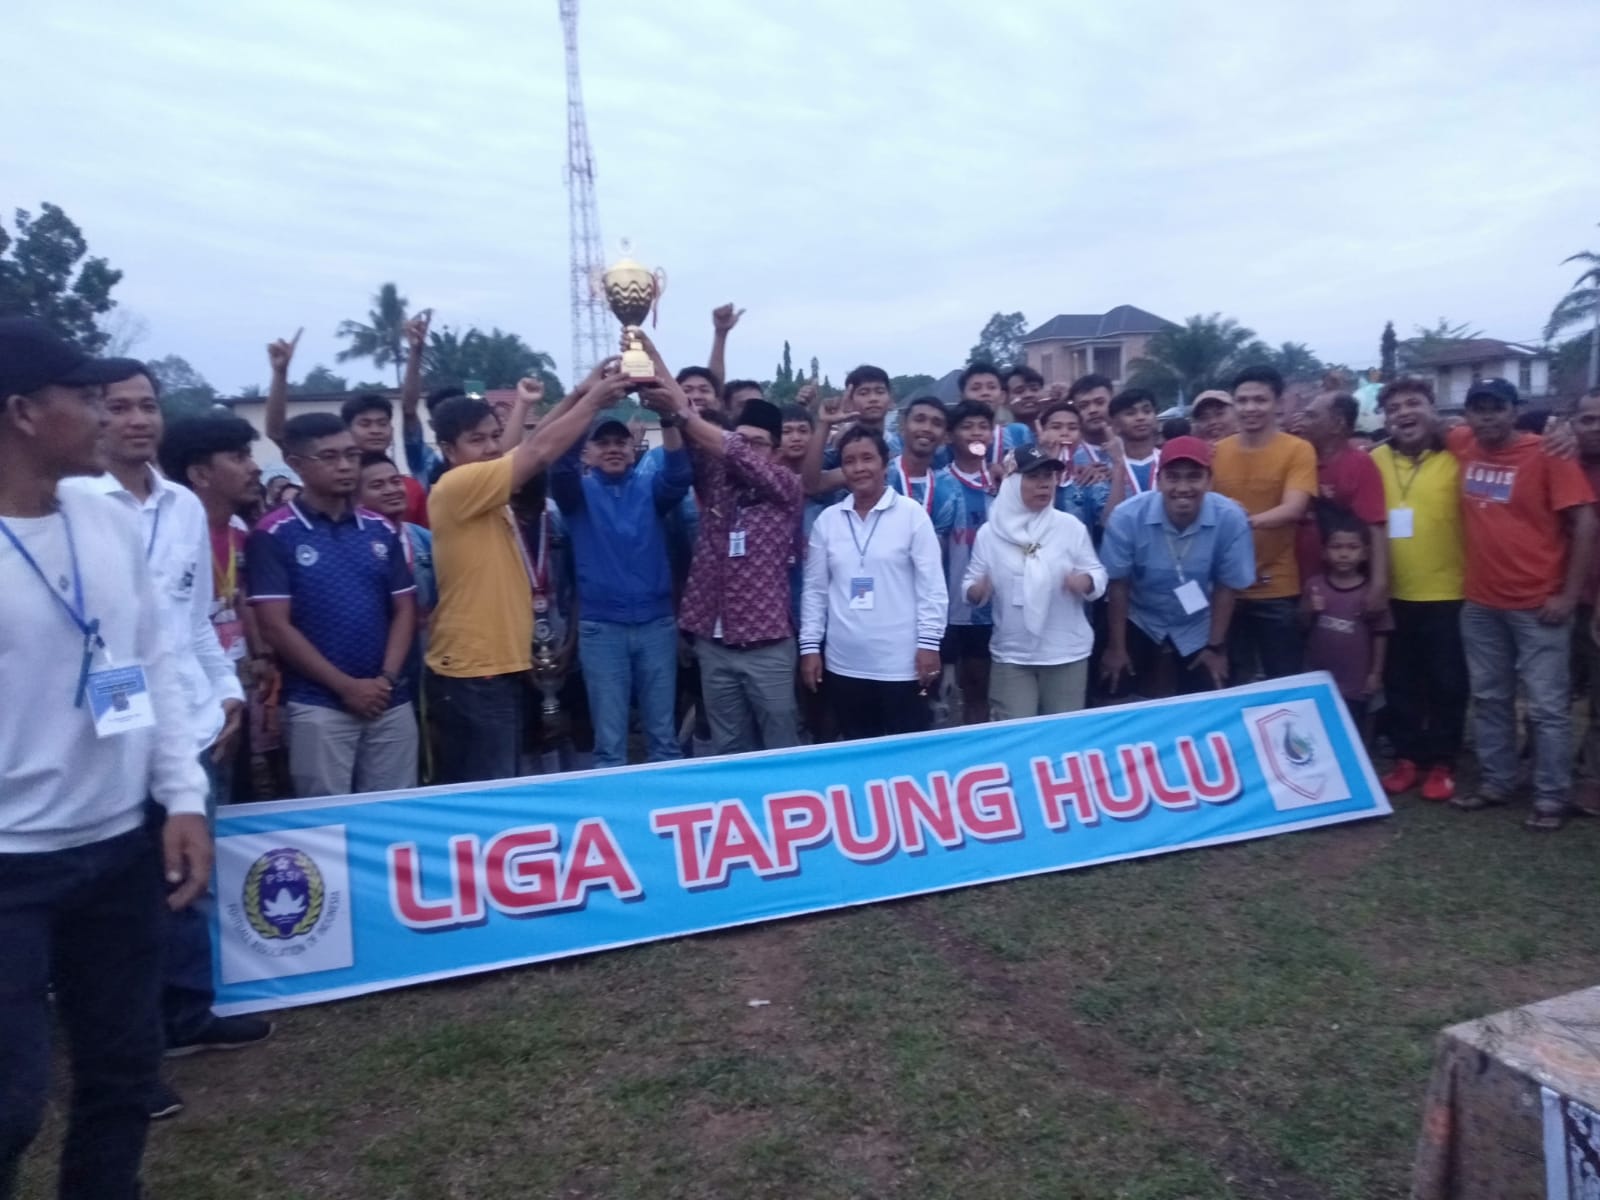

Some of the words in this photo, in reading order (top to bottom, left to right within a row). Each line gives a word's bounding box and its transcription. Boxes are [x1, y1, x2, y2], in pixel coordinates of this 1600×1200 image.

[265, 870, 300, 884] PSSI
[388, 816, 644, 930] LIGA
[651, 763, 1022, 888] TAPUNG
[1032, 732, 1241, 829] HULU
